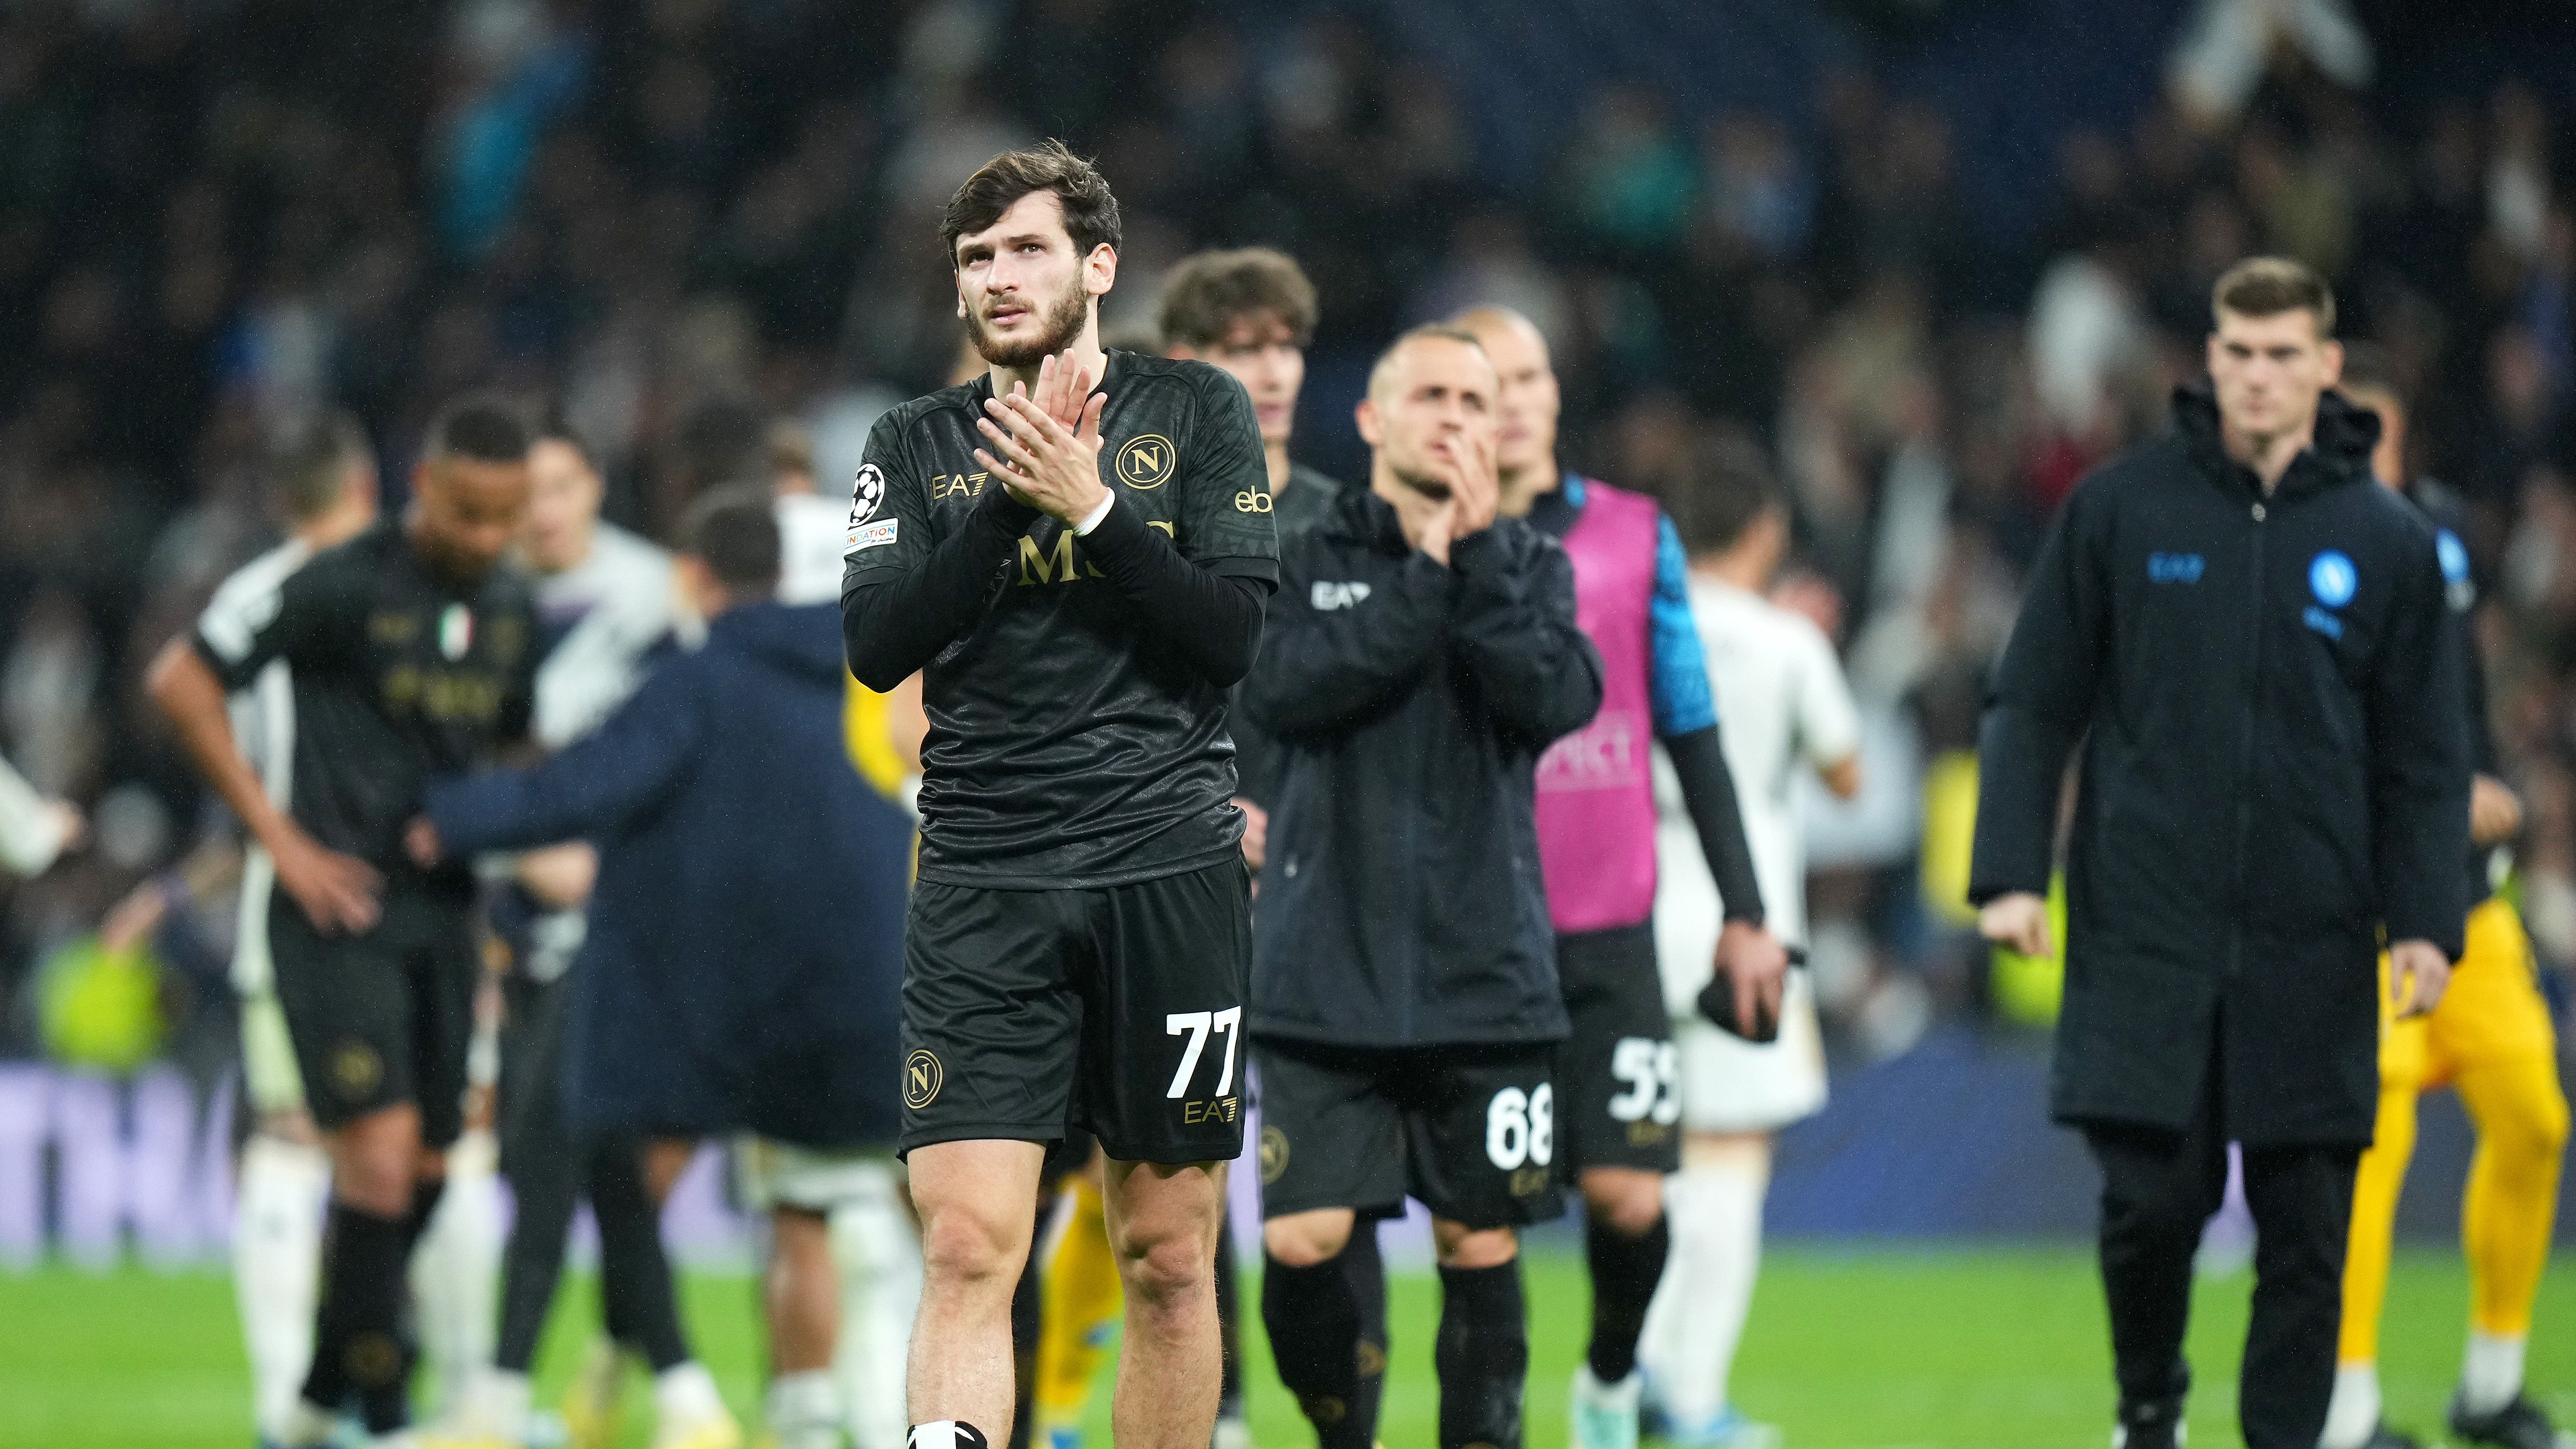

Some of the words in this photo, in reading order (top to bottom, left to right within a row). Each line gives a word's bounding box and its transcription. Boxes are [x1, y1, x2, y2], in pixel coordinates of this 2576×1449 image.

[932, 471, 989, 500] EA7
[1166, 1005, 1242, 1099] 77
[1184, 1096, 1238, 1124] EA7
[1485, 1081, 1553, 1171] 68
